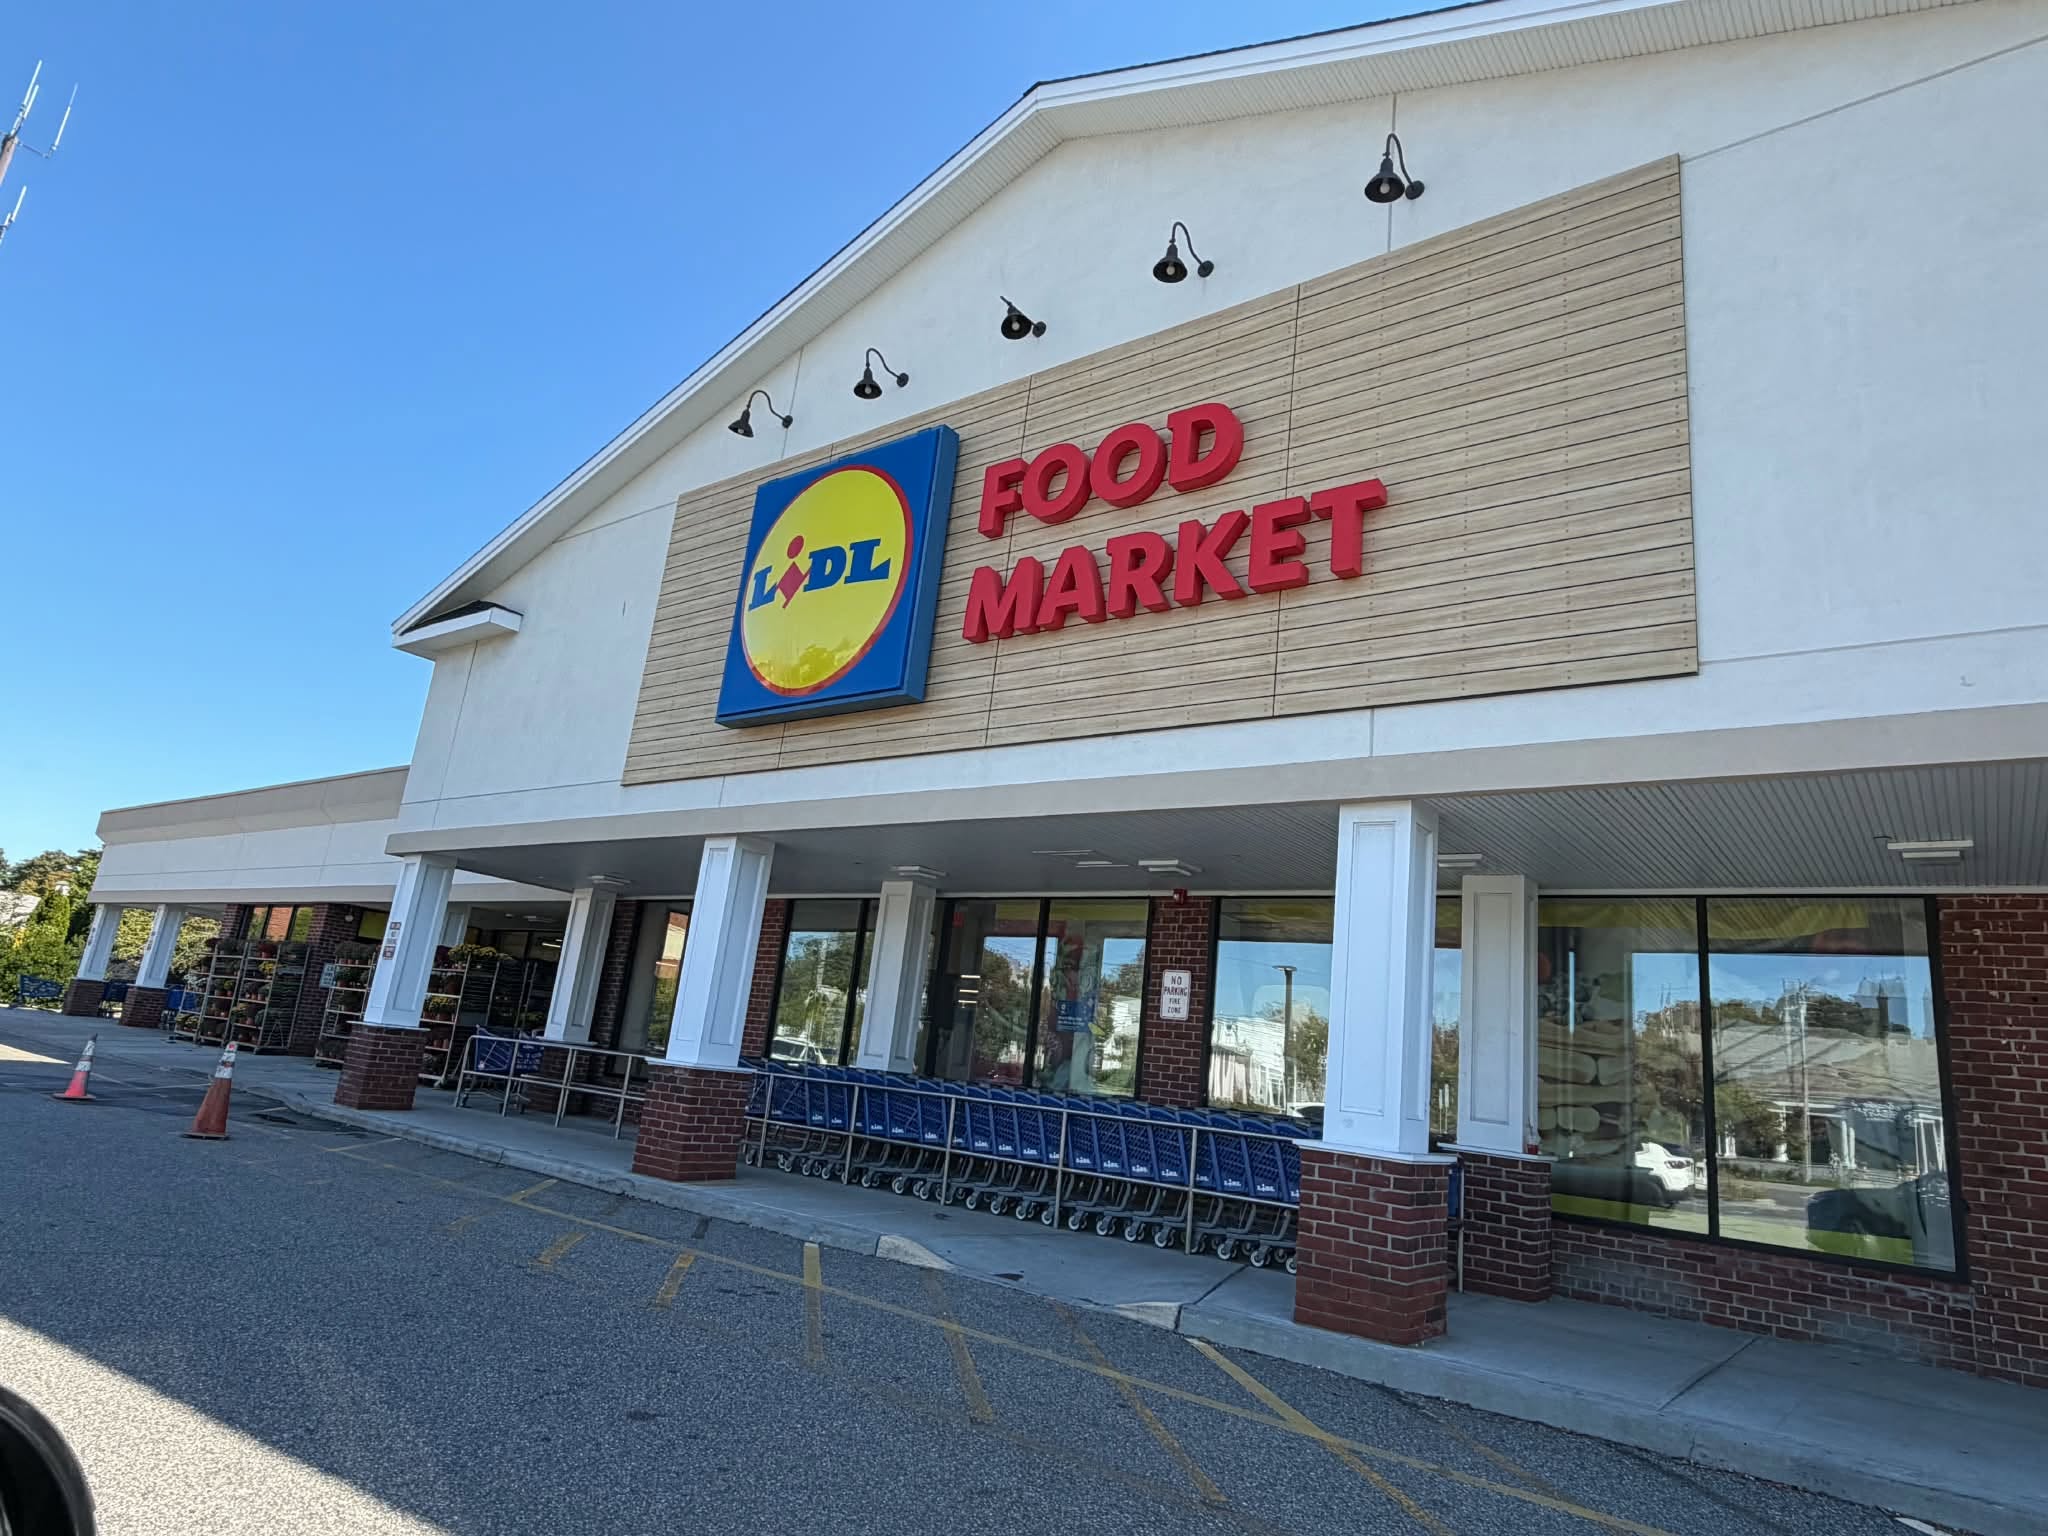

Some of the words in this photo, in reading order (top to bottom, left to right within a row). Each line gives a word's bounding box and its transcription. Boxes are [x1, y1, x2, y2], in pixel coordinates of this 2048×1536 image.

[978, 402, 1243, 538] FOOD
[962, 477, 1388, 643] MARKET
[1164, 986, 1188, 996] PARKING
[1171, 975, 1182, 985] NO
